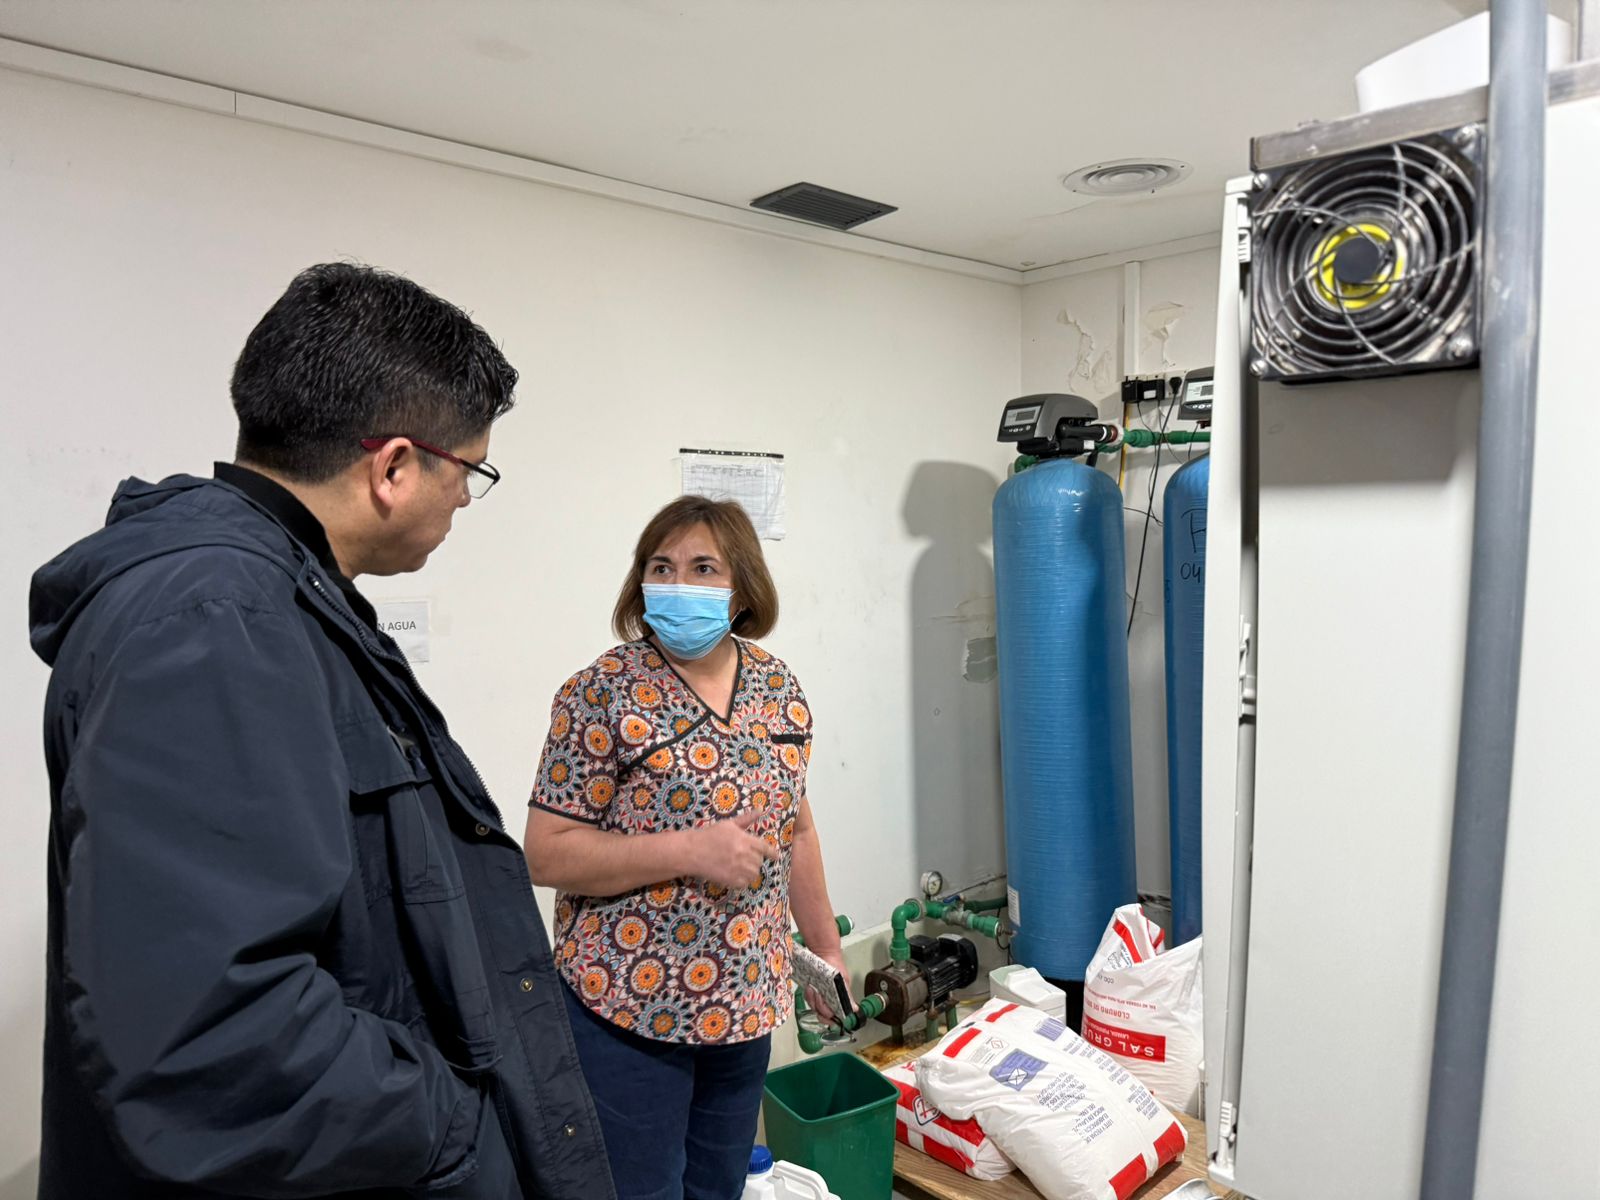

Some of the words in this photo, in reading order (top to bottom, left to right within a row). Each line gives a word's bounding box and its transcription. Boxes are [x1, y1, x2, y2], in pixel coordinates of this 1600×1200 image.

[1180, 562, 1201, 583] 04
[387, 620, 417, 631] AGUA
[1100, 1006, 1130, 1019] CLORURO
[1119, 1041, 1154, 1056] SAL
